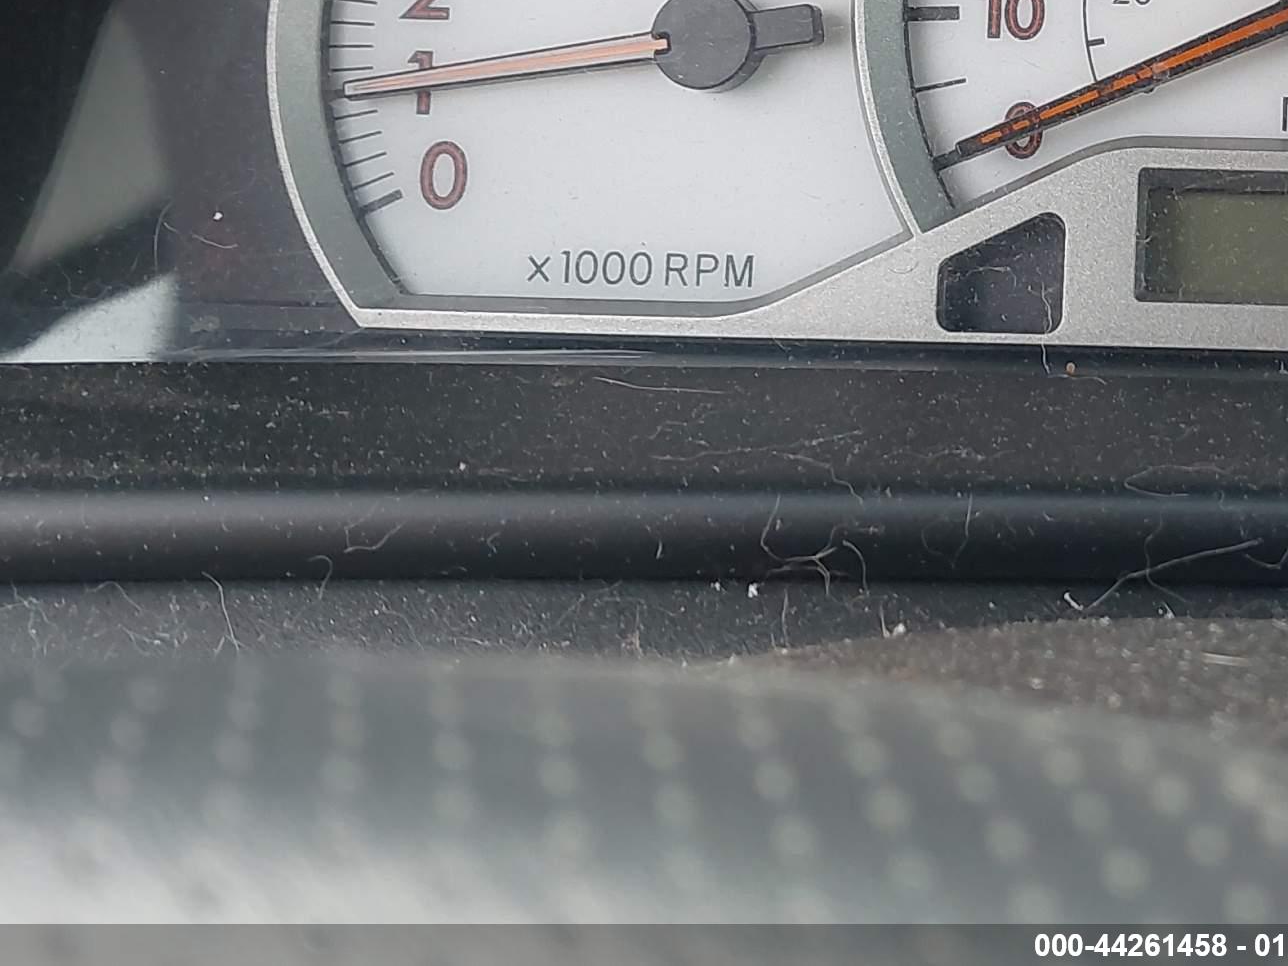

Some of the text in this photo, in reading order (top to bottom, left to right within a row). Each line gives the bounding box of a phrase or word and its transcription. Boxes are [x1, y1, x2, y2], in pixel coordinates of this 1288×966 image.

[407, 50, 433, 115] 1
[1005, 102, 1044, 160] 0
[420, 141, 467, 210] 0
[665, 253, 754, 288] RPM
